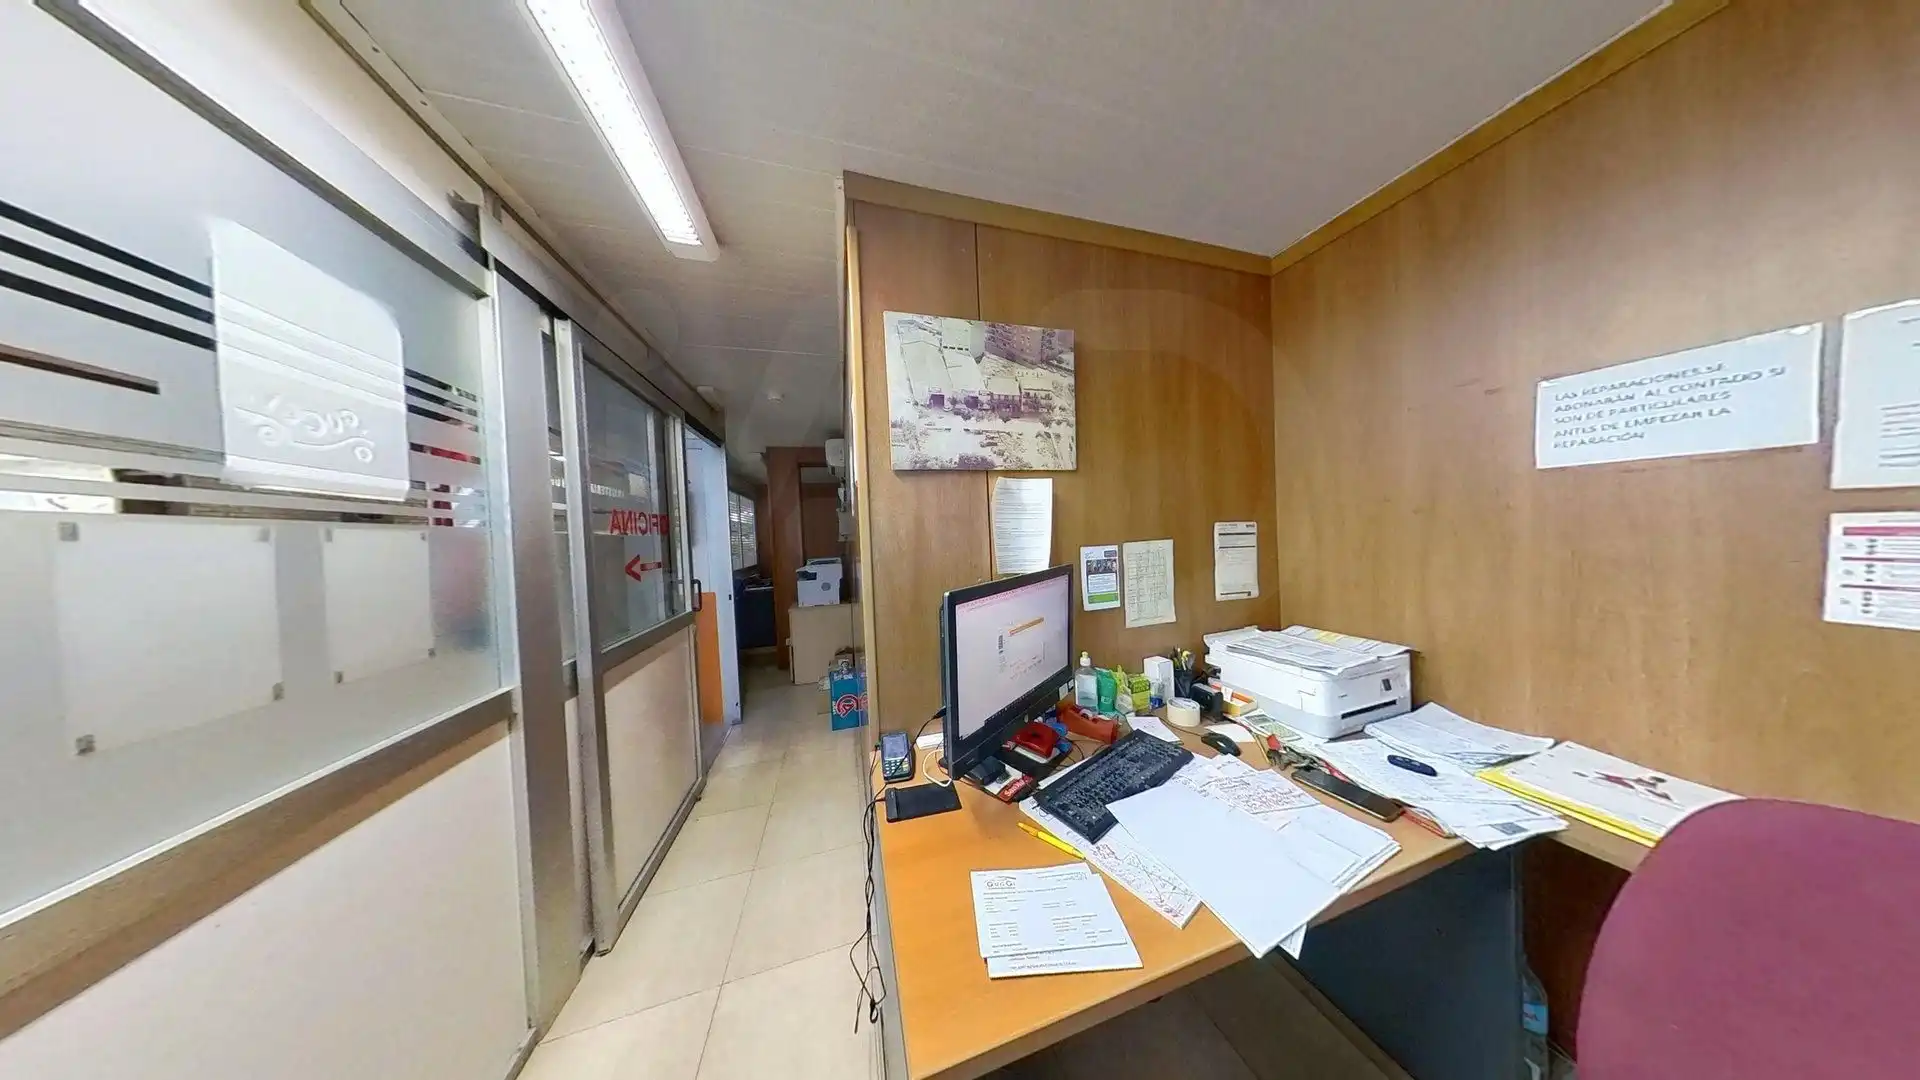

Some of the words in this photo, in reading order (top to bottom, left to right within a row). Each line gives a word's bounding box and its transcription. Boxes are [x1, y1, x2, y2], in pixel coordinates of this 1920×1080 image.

[1582, 367, 1700, 396] REPARACIONES
[1668, 371, 1763, 394] CONTADO
[1554, 415, 1582, 424] SON
[1586, 411, 1604, 420] DE
[1609, 391, 1732, 416] PARTICULARES
[1554, 425, 1597, 438] ANTES
[1601, 423, 1619, 431] DE
[1624, 411, 1702, 428] EMPEZAR
[1708, 407, 1731, 417] LA
